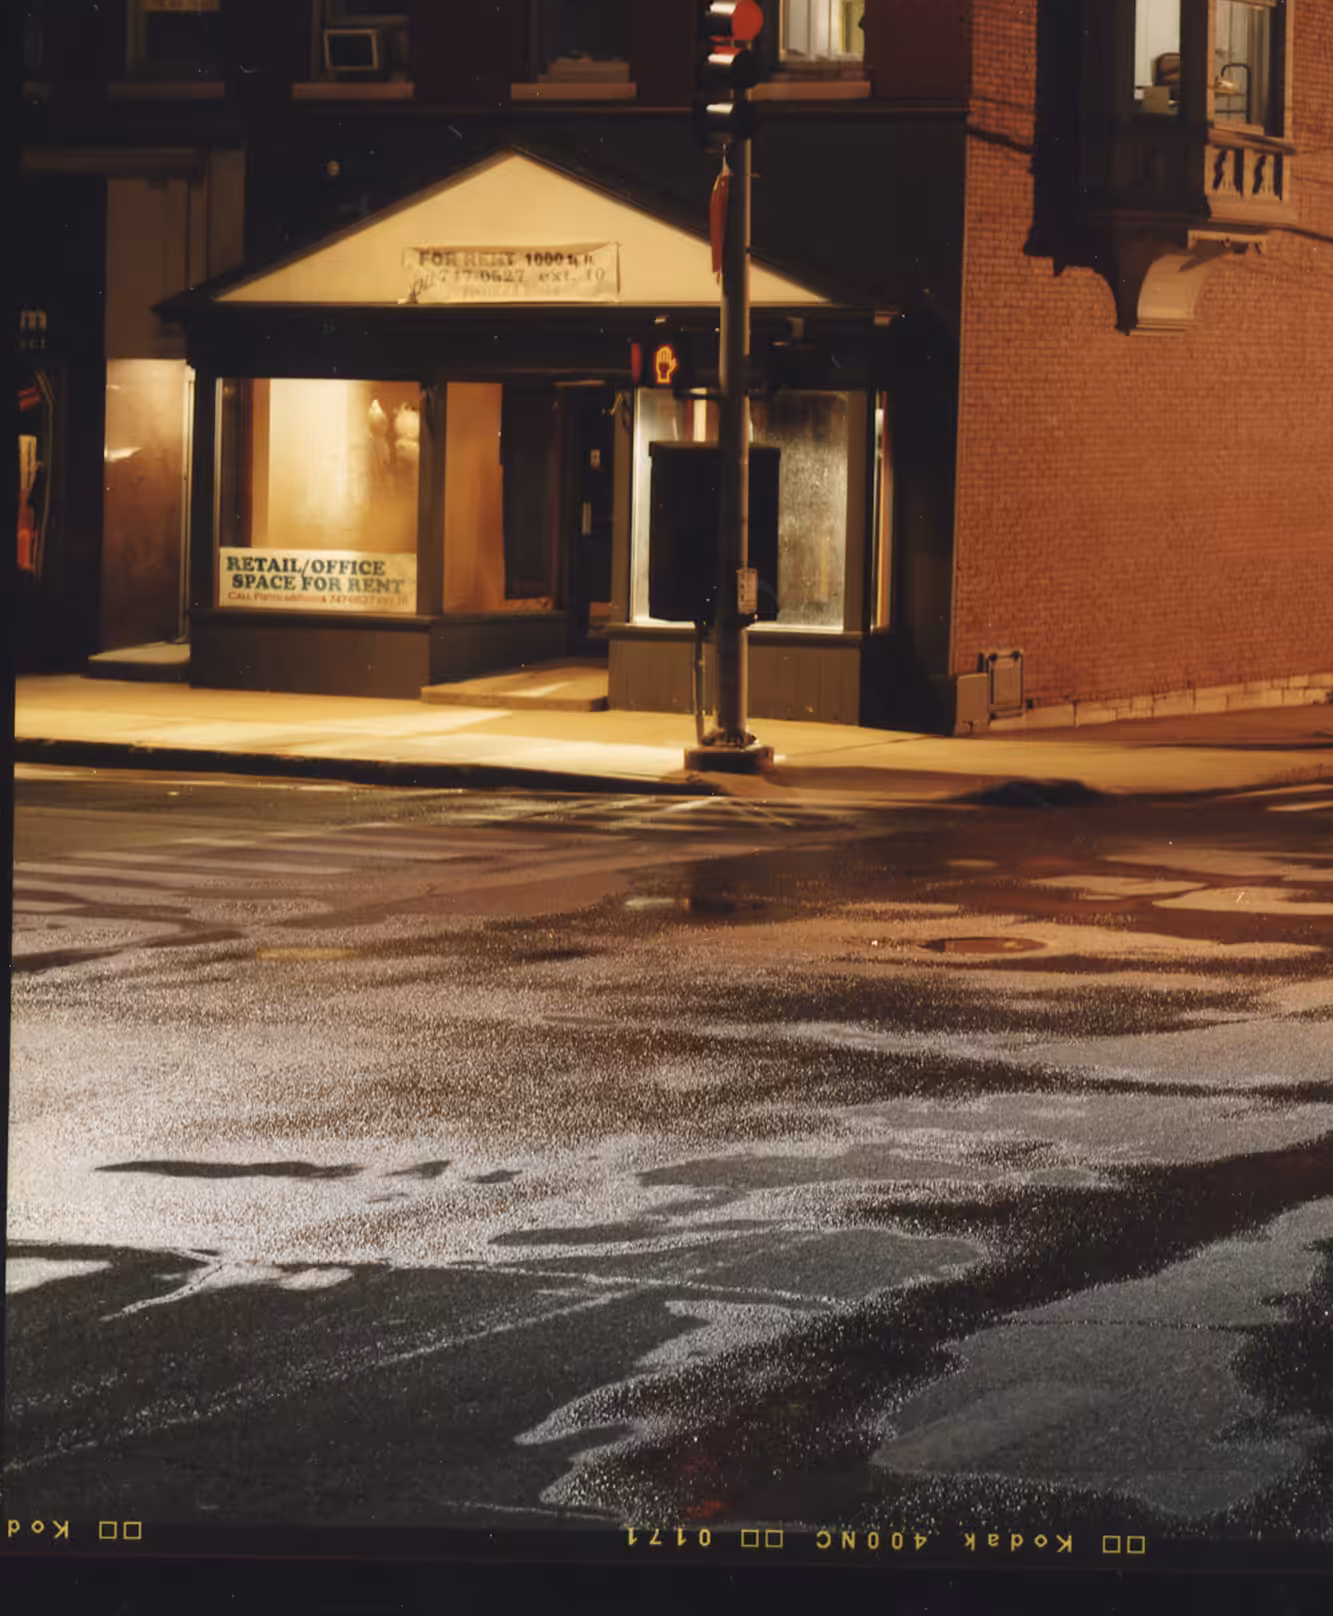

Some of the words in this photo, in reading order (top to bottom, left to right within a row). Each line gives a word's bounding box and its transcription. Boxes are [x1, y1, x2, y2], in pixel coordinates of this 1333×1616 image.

[418, 251, 459, 267] FOR
[226, 555, 386, 578] RETAIL/OFFICE
[232, 573, 296, 590] SPACE
[301, 576, 342, 592] FOR
[347, 577, 406, 595] RENT
[627, 1526, 711, 1547] 0171
[816, 1531, 927, 1551] 400NC
[965, 1533, 1073, 1553] Kodak
